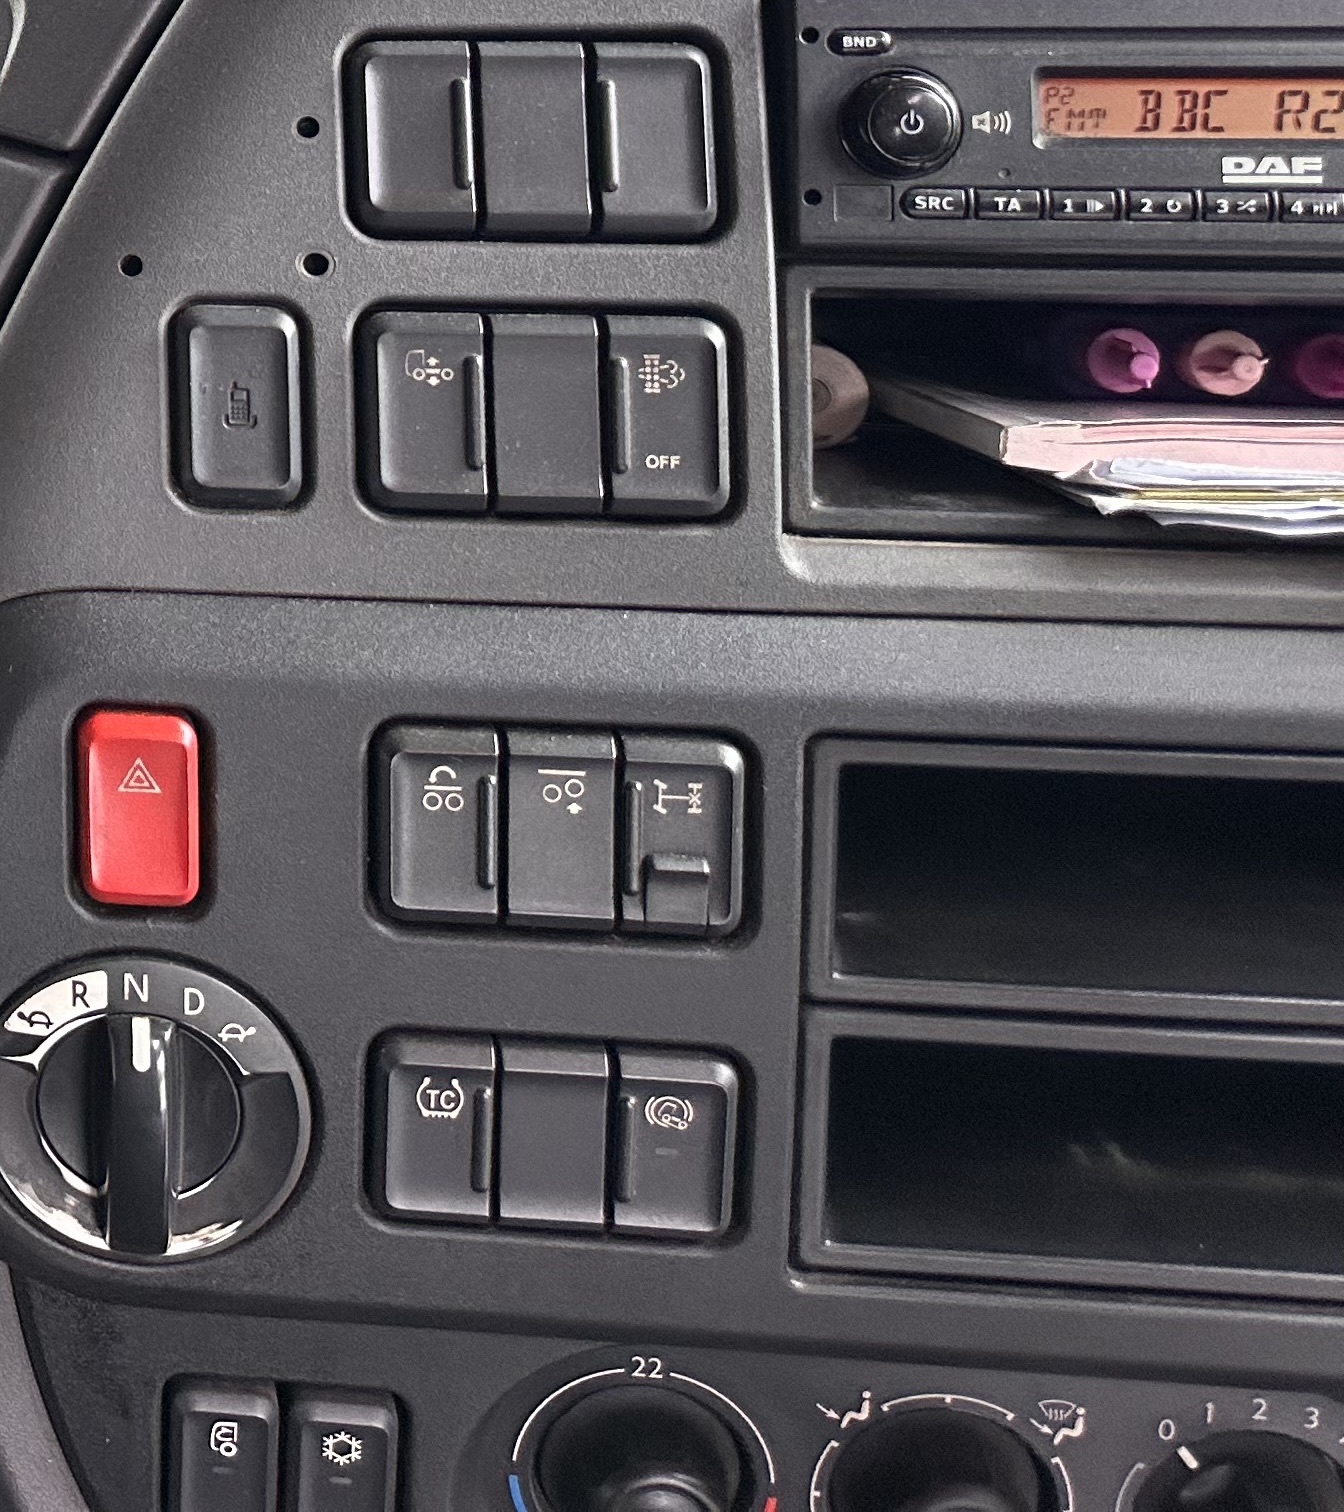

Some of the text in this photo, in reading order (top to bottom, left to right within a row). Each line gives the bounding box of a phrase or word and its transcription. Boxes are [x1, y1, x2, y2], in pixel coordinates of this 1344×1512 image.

[842, 36, 877, 48] BND
[1044, 86, 1075, 105] P2
[1133, 88, 1229, 133] BBC
[1221, 156, 1324, 175] DAF
[914, 195, 955, 211] SRC
[994, 197, 1022, 212] TA
[1063, 198, 1074, 213] 1
[1140, 197, 1154, 213] 2
[1215, 198, 1230, 214] 3
[1290, 199, 1305, 215] 4
[645, 454, 681, 469] OFF
[71, 972, 205, 1016] R N D
[425, 1089, 457, 1110] TC
[631, 1355, 663, 1379] 22
[1158, 1397, 1320, 1441] 0 1 2 3
